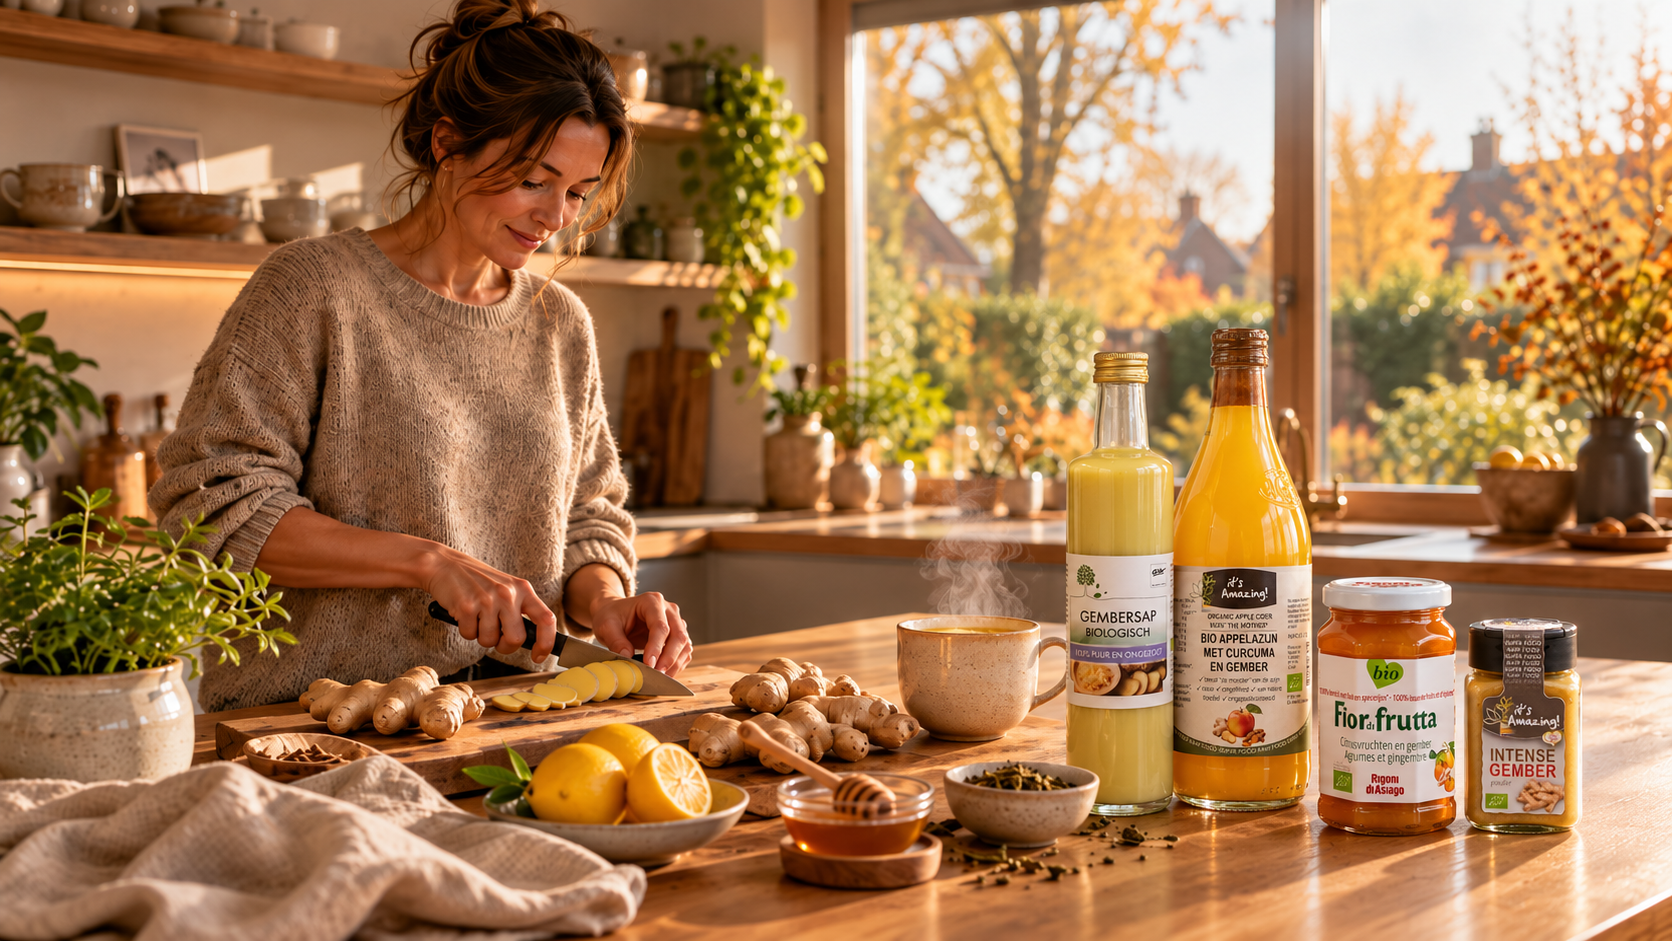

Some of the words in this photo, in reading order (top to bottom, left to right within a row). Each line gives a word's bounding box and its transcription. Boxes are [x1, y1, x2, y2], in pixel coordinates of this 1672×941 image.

[1227, 576, 1244, 588] it's
[1221, 587, 1269, 602] Amazing!
[1080, 610, 1157, 624] GEMBERSAP
[1085, 627, 1151, 638] BIOLOGISCH
[1201, 633, 1217, 644] BIO
[1203, 647, 1224, 658] MET
[1226, 647, 1275, 658] CURCUMA
[1210, 661, 1224, 672] EN
[1226, 661, 1269, 672] GEMBER
[1373, 665, 1399, 681] bio
[1334, 700, 1370, 731] Fior
[1366, 721, 1375, 730] di
[1375, 706, 1438, 732] frutta
[1514, 703, 1533, 716] it's
[1507, 715, 1560, 730] Amazing!
[1394, 742, 1405, 751] en
[1377, 753, 1386, 763] et
[1387, 752, 1427, 766] gingembre
[1490, 748, 1556, 763] INTENSE
[1489, 763, 1557, 778] GEMBER
[1371, 773, 1399, 786] Rigoni
